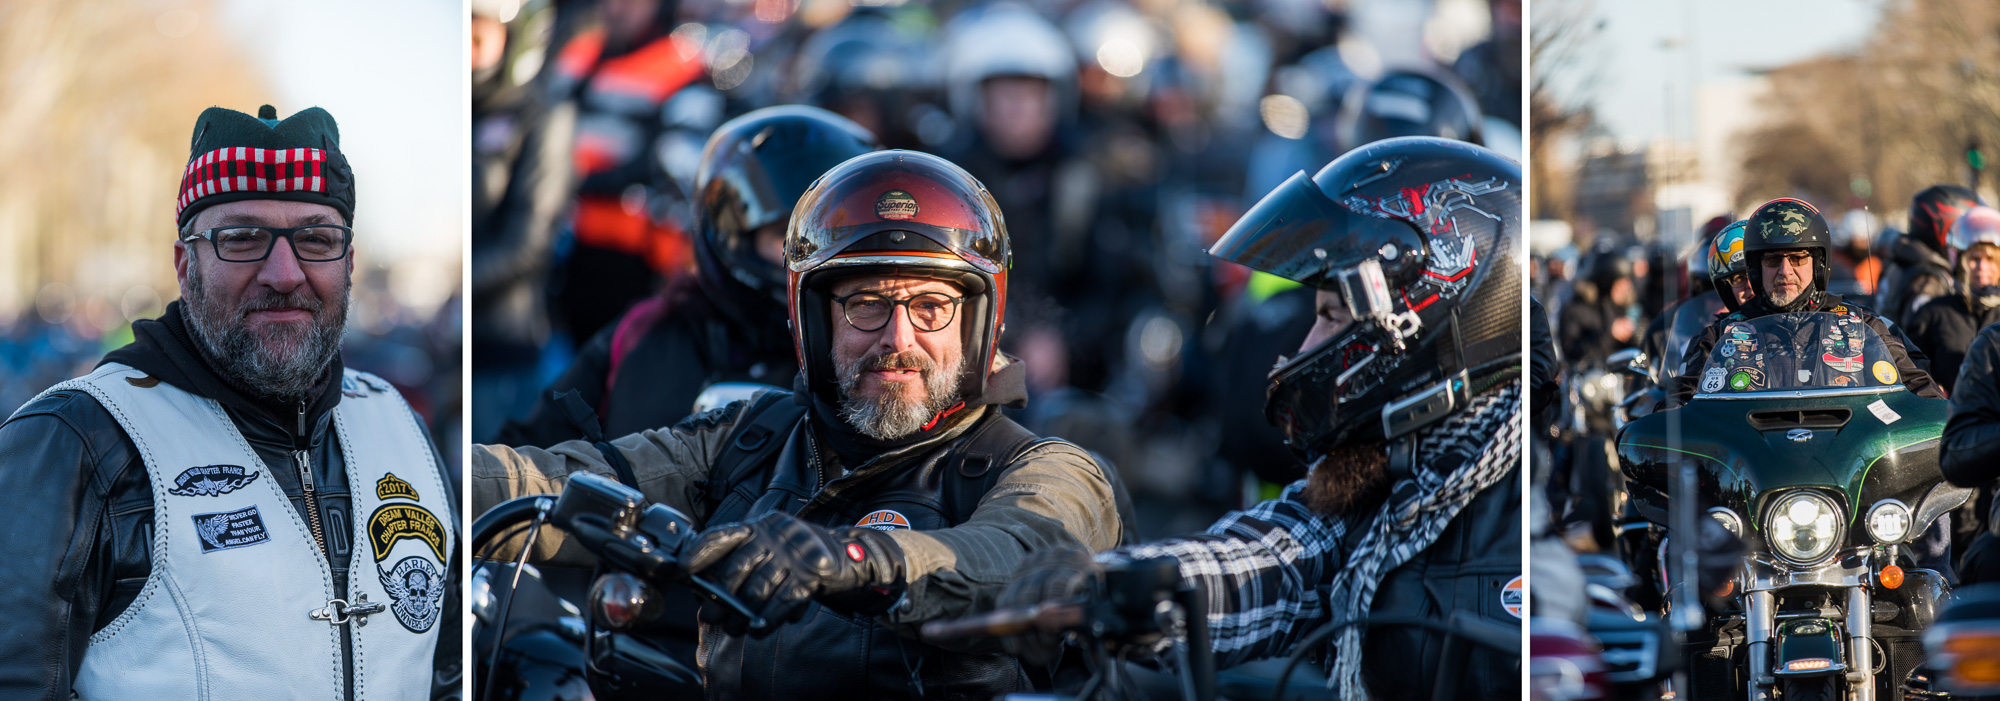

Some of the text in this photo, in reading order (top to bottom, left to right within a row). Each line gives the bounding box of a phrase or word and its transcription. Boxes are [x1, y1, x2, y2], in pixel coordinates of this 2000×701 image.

[877, 200, 918, 211] Superior
[1707, 380, 1719, 389] 66
[383, 482, 406, 494] 2017
[228, 511, 248, 521] NEVER
[378, 509, 403, 527] DREAM
[868, 511, 896, 524] H.D
[231, 518, 255, 529] FASTER
[230, 525, 262, 537] THAN YOUR
[380, 520, 441, 547] CHAPTER FRANCE
[225, 532, 266, 546] ANGEL CAN FLY
[396, 559, 436, 577] HARLEY
[396, 606, 423, 630] OWNERS
